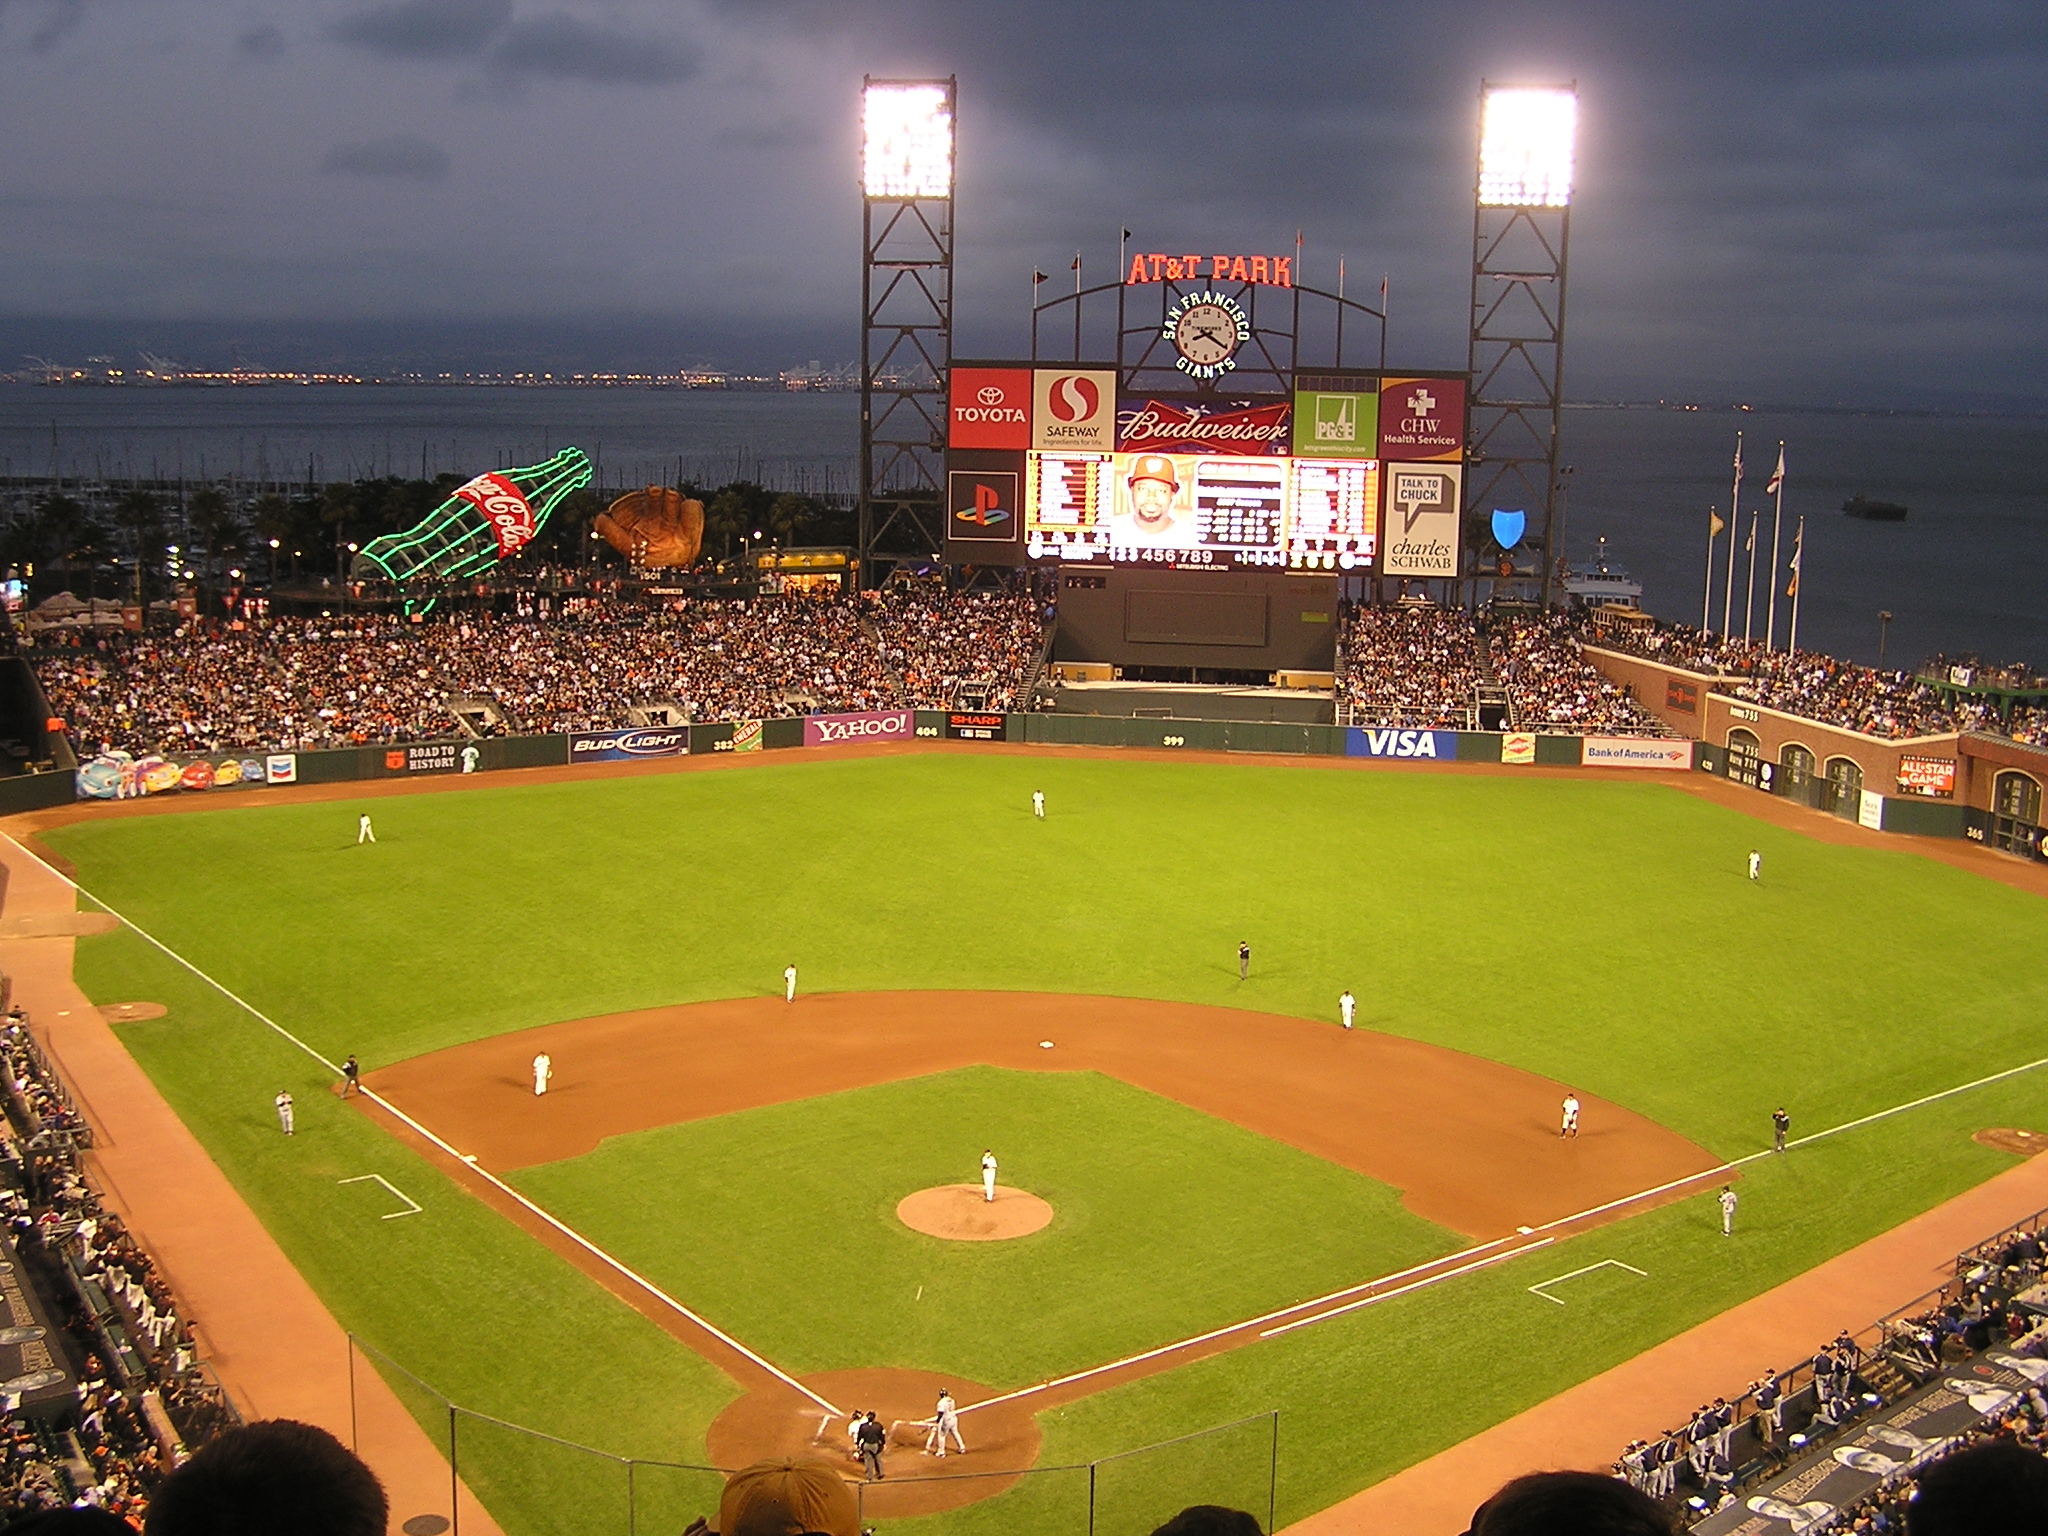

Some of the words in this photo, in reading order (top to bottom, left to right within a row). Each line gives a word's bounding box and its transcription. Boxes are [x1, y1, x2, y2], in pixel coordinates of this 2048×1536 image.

[1127, 254, 1201, 285] AT&T
[1212, 255, 1291, 287] PARK
[1163, 306, 1182, 340] SAN
[1180, 291, 1250, 341] FRANCISCO
[1175, 356, 1236, 379] GIANTS
[954, 407, 1026, 423] TOYOTA
[1117, 407, 1288, 441] Budweiser
[1318, 421, 1353, 438] PG&E
[1400, 419, 1440, 433] CHW
[1047, 426, 1100, 437] SAFEWAY
[1042, 438, 1079, 446] Ingredients
[1384, 434, 1416, 444] Health
[1417, 436, 1456, 446] Services
[1401, 479, 1424, 488] TALK
[1425, 479, 1438, 488] TO
[1400, 489, 1438, 500] CHUCK
[1392, 538, 1451, 556] charles
[1390, 556, 1451, 569] SCHWAB
[950, 715, 1002, 725] SHARP
[812, 714, 907, 741] YAHOO!
[916, 726, 938, 737] 404
[573, 740, 616, 751] BUD
[625, 734, 682, 747] LIGHT
[1163, 735, 1184, 746] 399
[1362, 729, 1437, 758] VISA
[409, 747, 440, 758] ROAD
[440, 745, 455, 756] TO
[1588, 747, 1613, 757] Bank
[1613, 748, 1624, 757] of
[1624, 749, 1664, 759] America
[409, 757, 455, 770] HISTORY
[1909, 772, 1944, 786] GAME
[1966, 826, 1983, 840] 365
